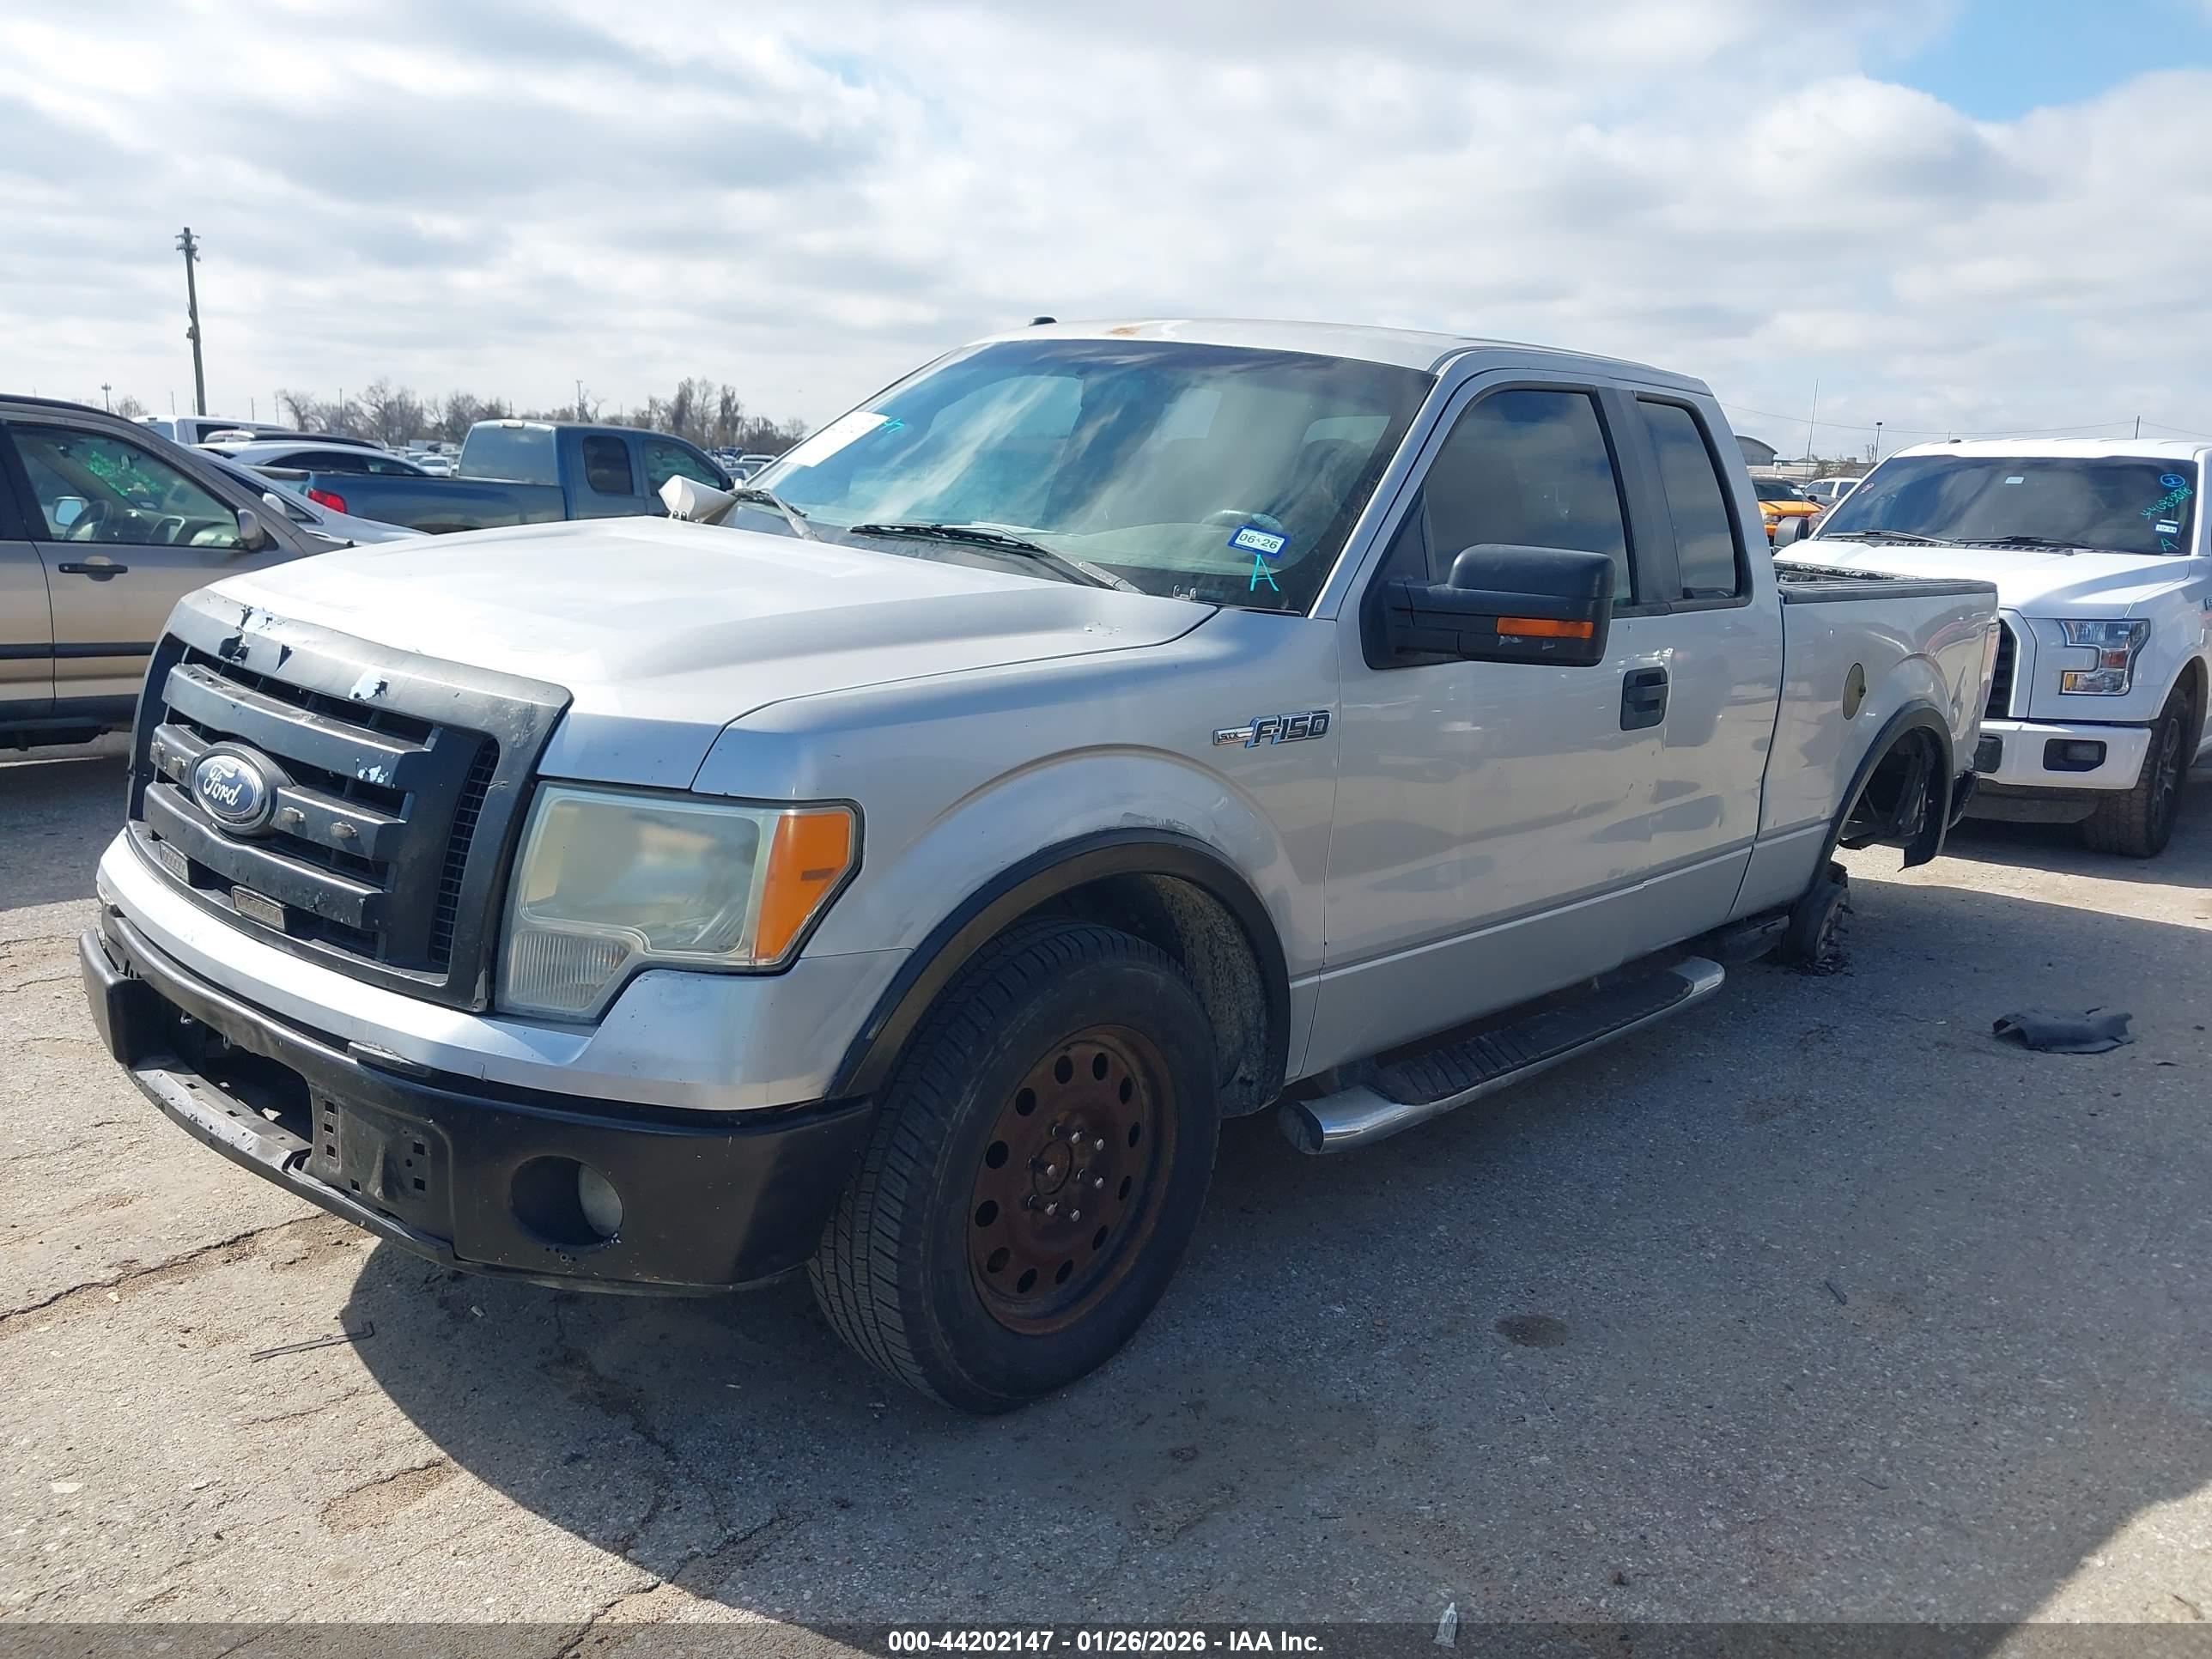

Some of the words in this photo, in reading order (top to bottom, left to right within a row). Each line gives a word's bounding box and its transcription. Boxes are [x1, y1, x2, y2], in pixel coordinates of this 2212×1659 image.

[2160, 538, 2179, 551] A
[1249, 554, 1279, 592] A
[1247, 711, 1331, 747] F-150
[203, 764, 243, 806] Ford
